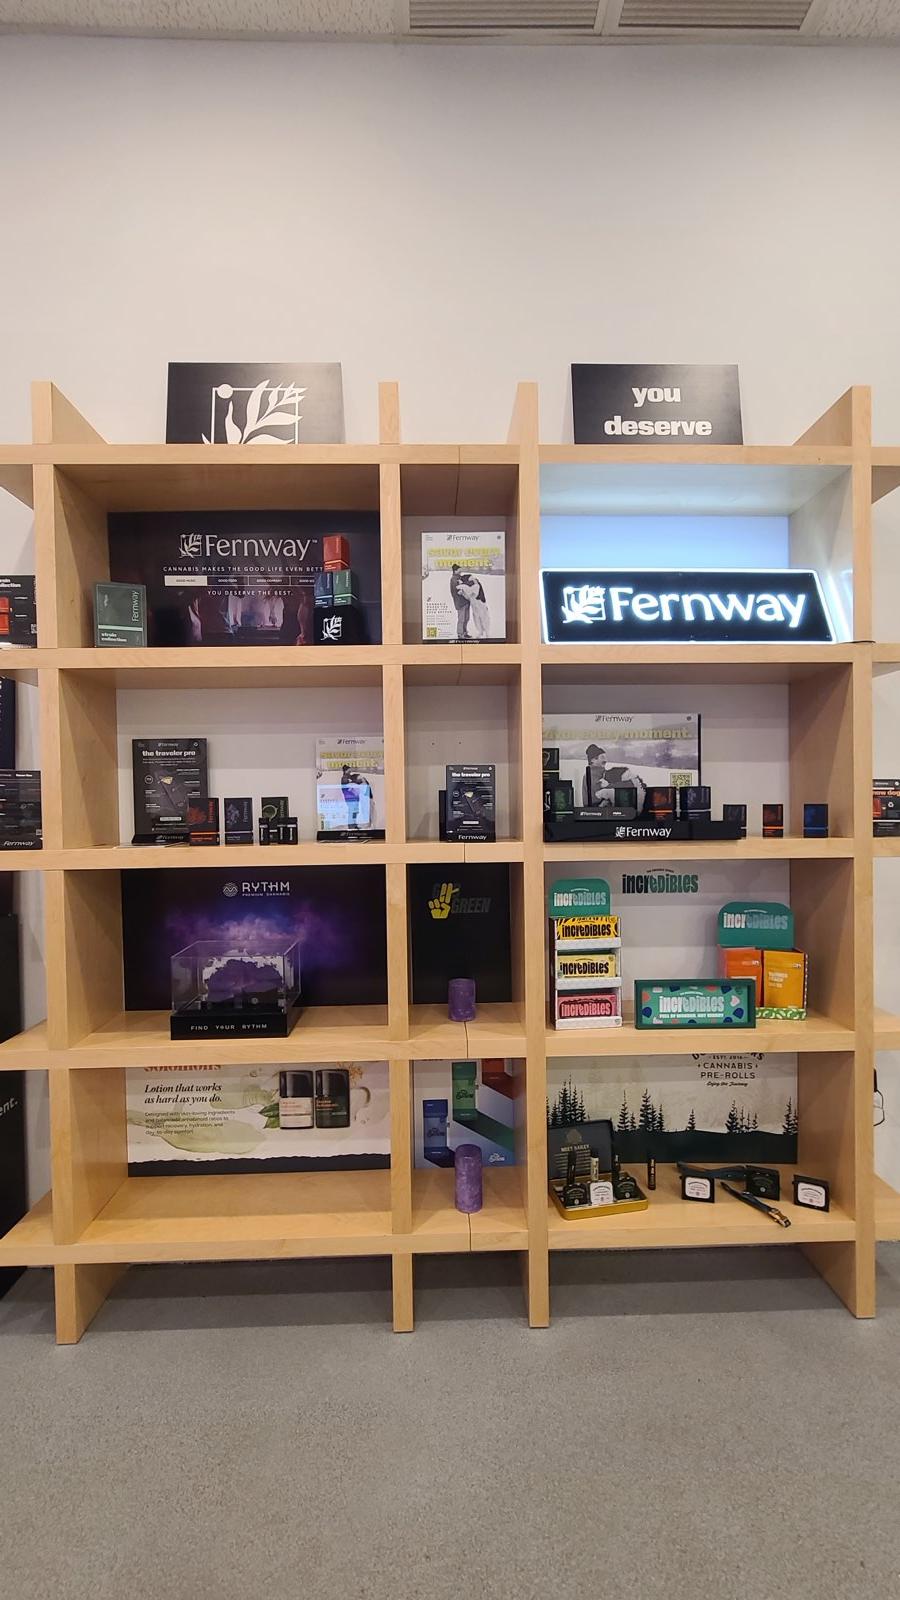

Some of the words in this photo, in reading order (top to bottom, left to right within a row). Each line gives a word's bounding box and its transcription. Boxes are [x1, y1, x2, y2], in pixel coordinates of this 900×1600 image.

[632, 385, 682, 408] you
[604, 416, 712, 436] deserve
[610, 585, 807, 628] Fernway
[626, 826, 672, 838] Fernway
[242, 882, 290, 892] RYTHM
[703, 1062, 753, 1070] CANNABIS
[144, 1084, 174, 1093] Lotion
[175, 1083, 194, 1092] that
[195, 1082, 222, 1092] works
[156, 1094, 179, 1104] hard
[190, 1096, 208, 1106] you
[208, 1094, 222, 1102] do.
